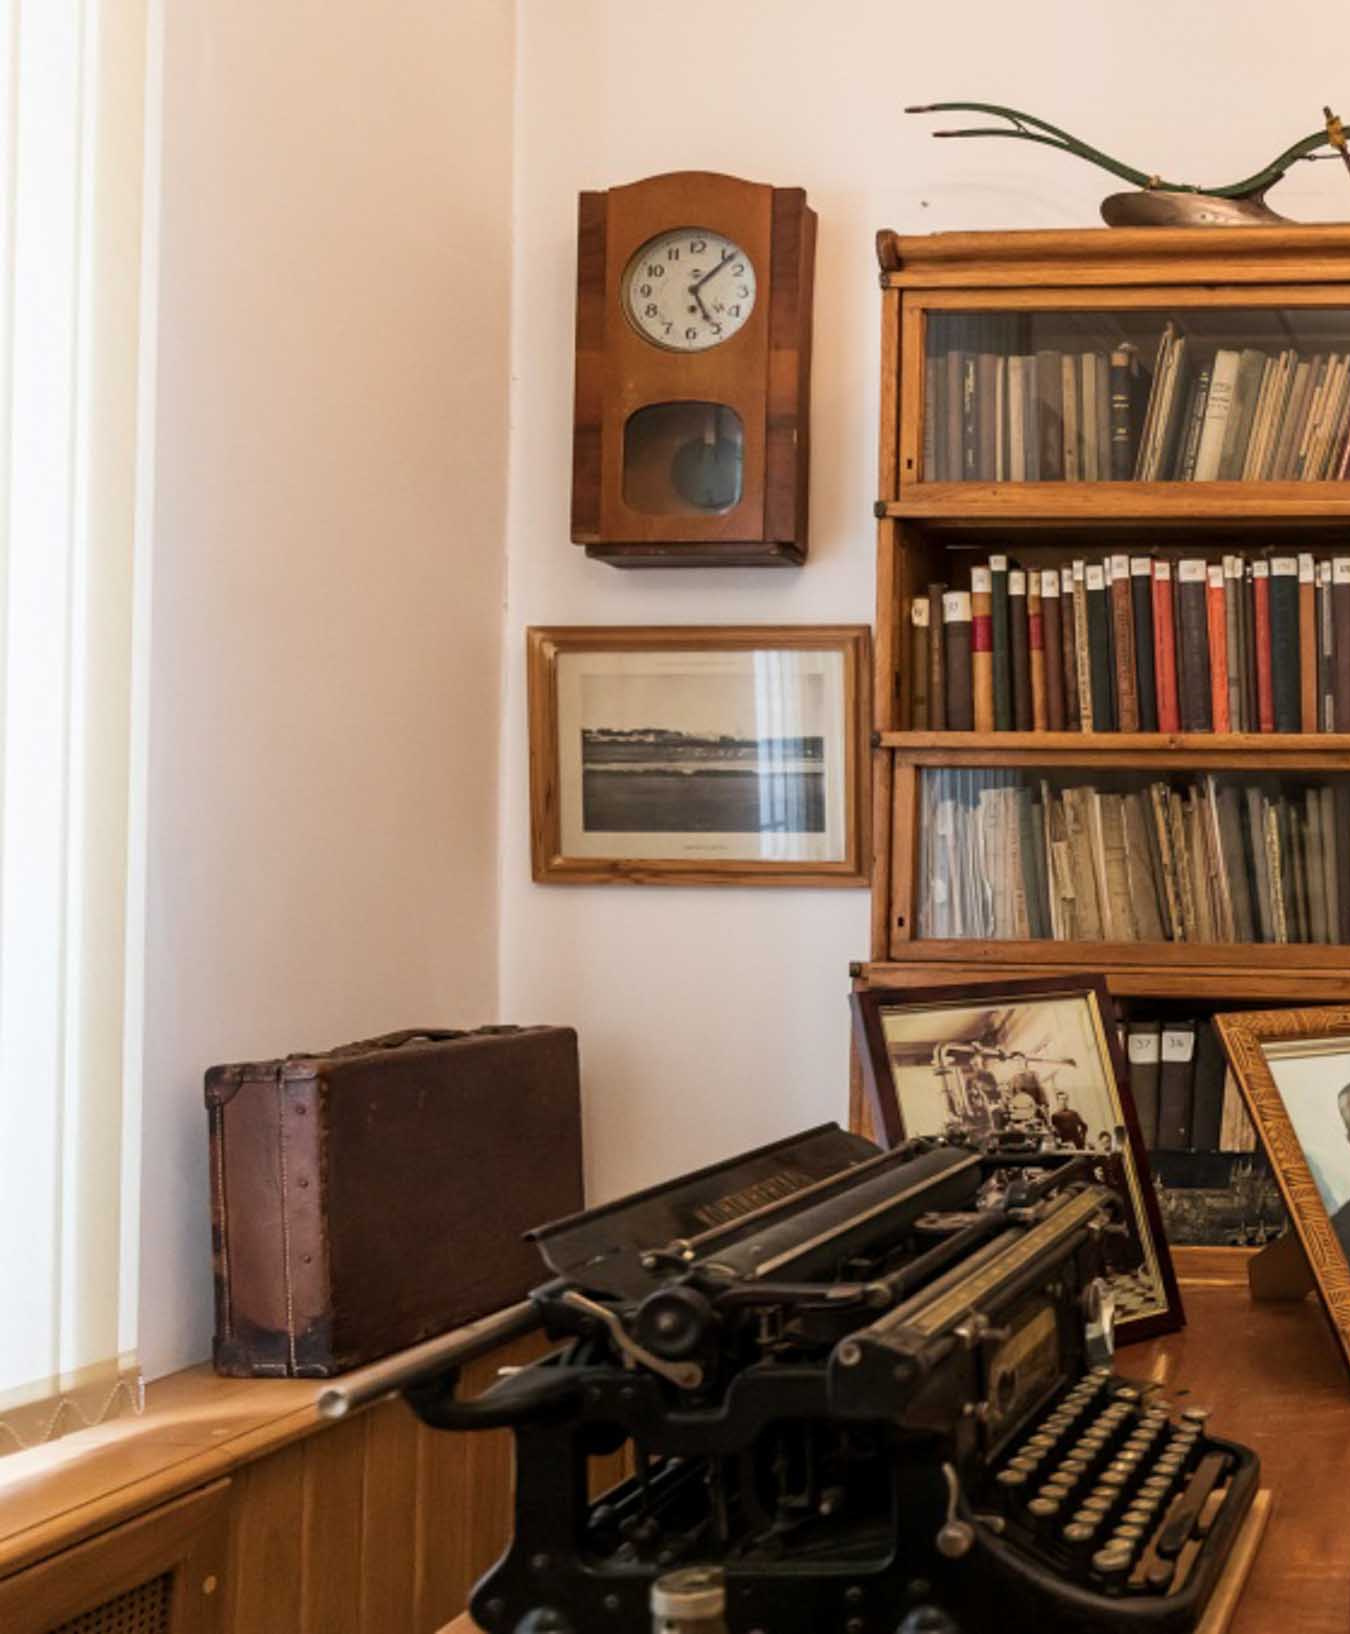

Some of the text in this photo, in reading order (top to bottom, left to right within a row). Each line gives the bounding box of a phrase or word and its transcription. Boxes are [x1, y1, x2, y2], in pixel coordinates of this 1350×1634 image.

[690, 241, 707, 254] 12
[667, 248, 680, 261] 11
[647, 264, 665, 277] 10
[733, 264, 745, 277] 2
[640, 284, 652, 298] 9
[736, 285, 749, 299] 3
[644, 303, 658, 318] 8
[728, 304, 740, 318] 4
[662, 322, 673, 335] 7
[685, 327, 697, 340] 6
